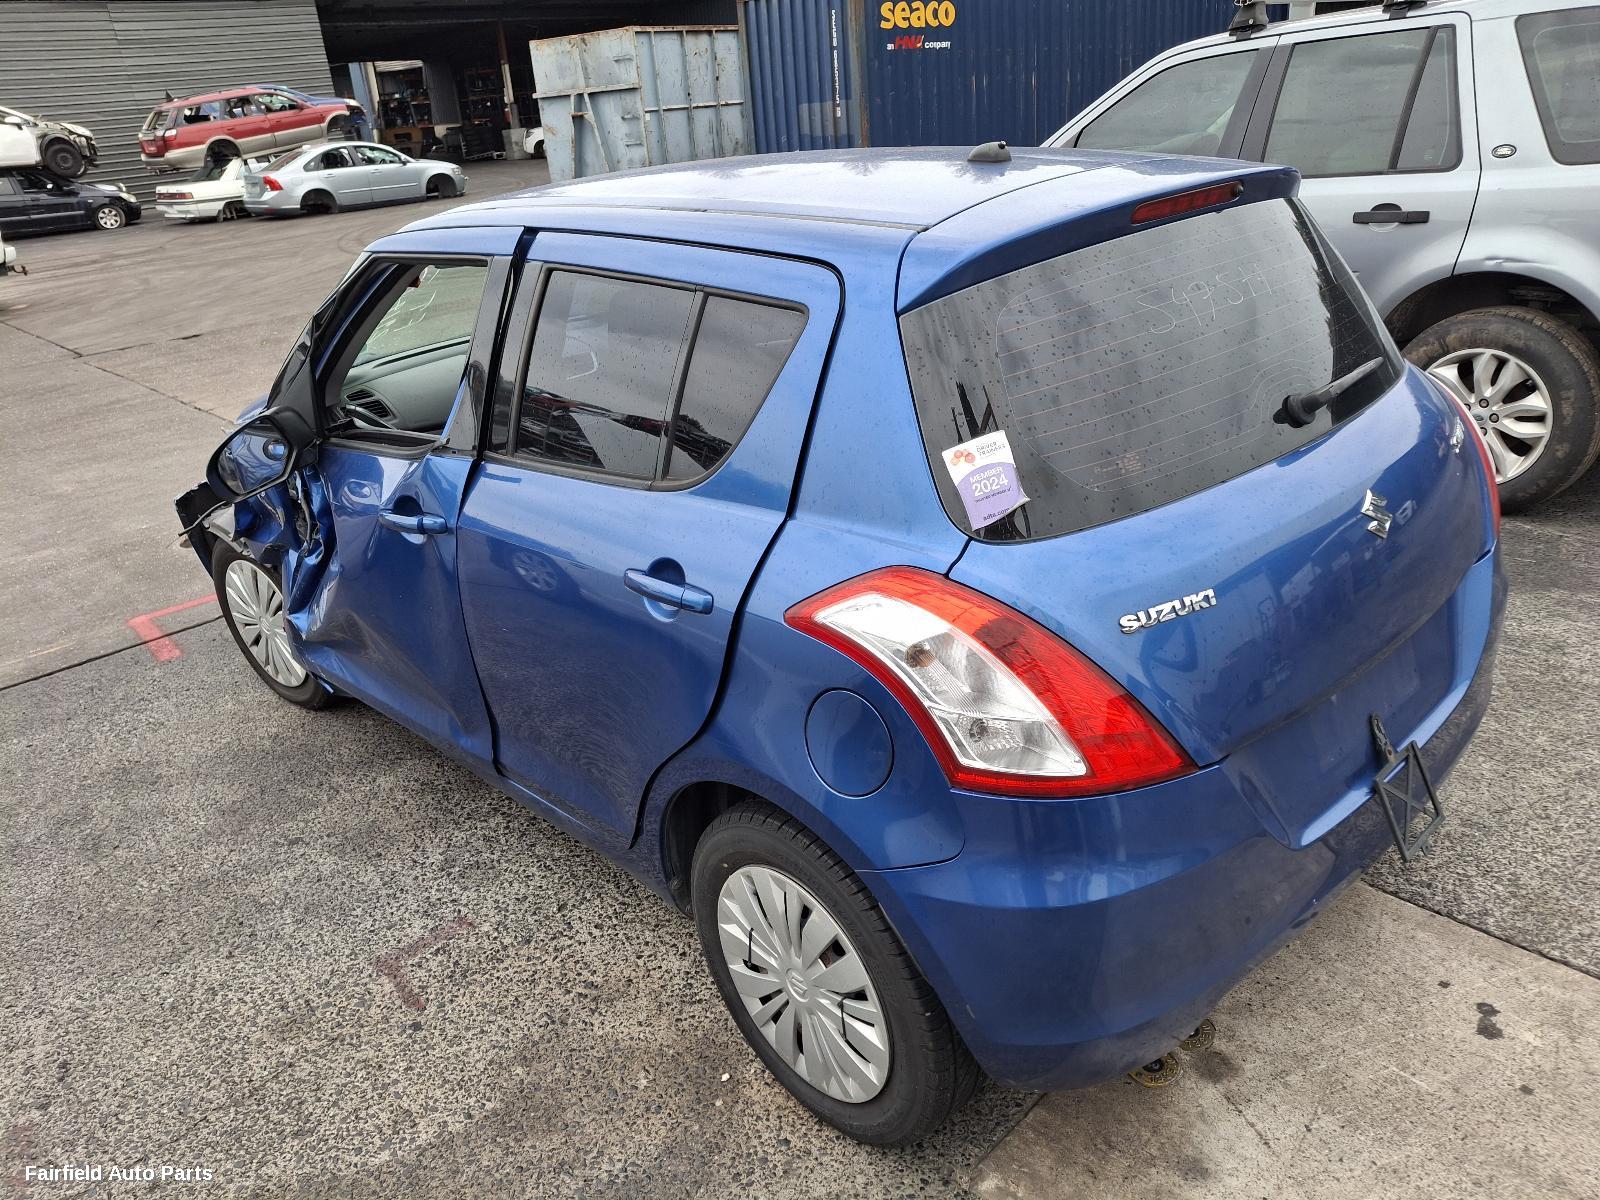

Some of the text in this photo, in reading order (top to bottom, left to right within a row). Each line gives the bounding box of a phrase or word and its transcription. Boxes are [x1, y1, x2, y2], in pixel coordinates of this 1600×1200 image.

[880, 0, 956, 30] seaco
[969, 466, 1003, 483] MEMBER
[972, 473, 1009, 497] 2024
[1119, 588, 1217, 634] SUZUKI
